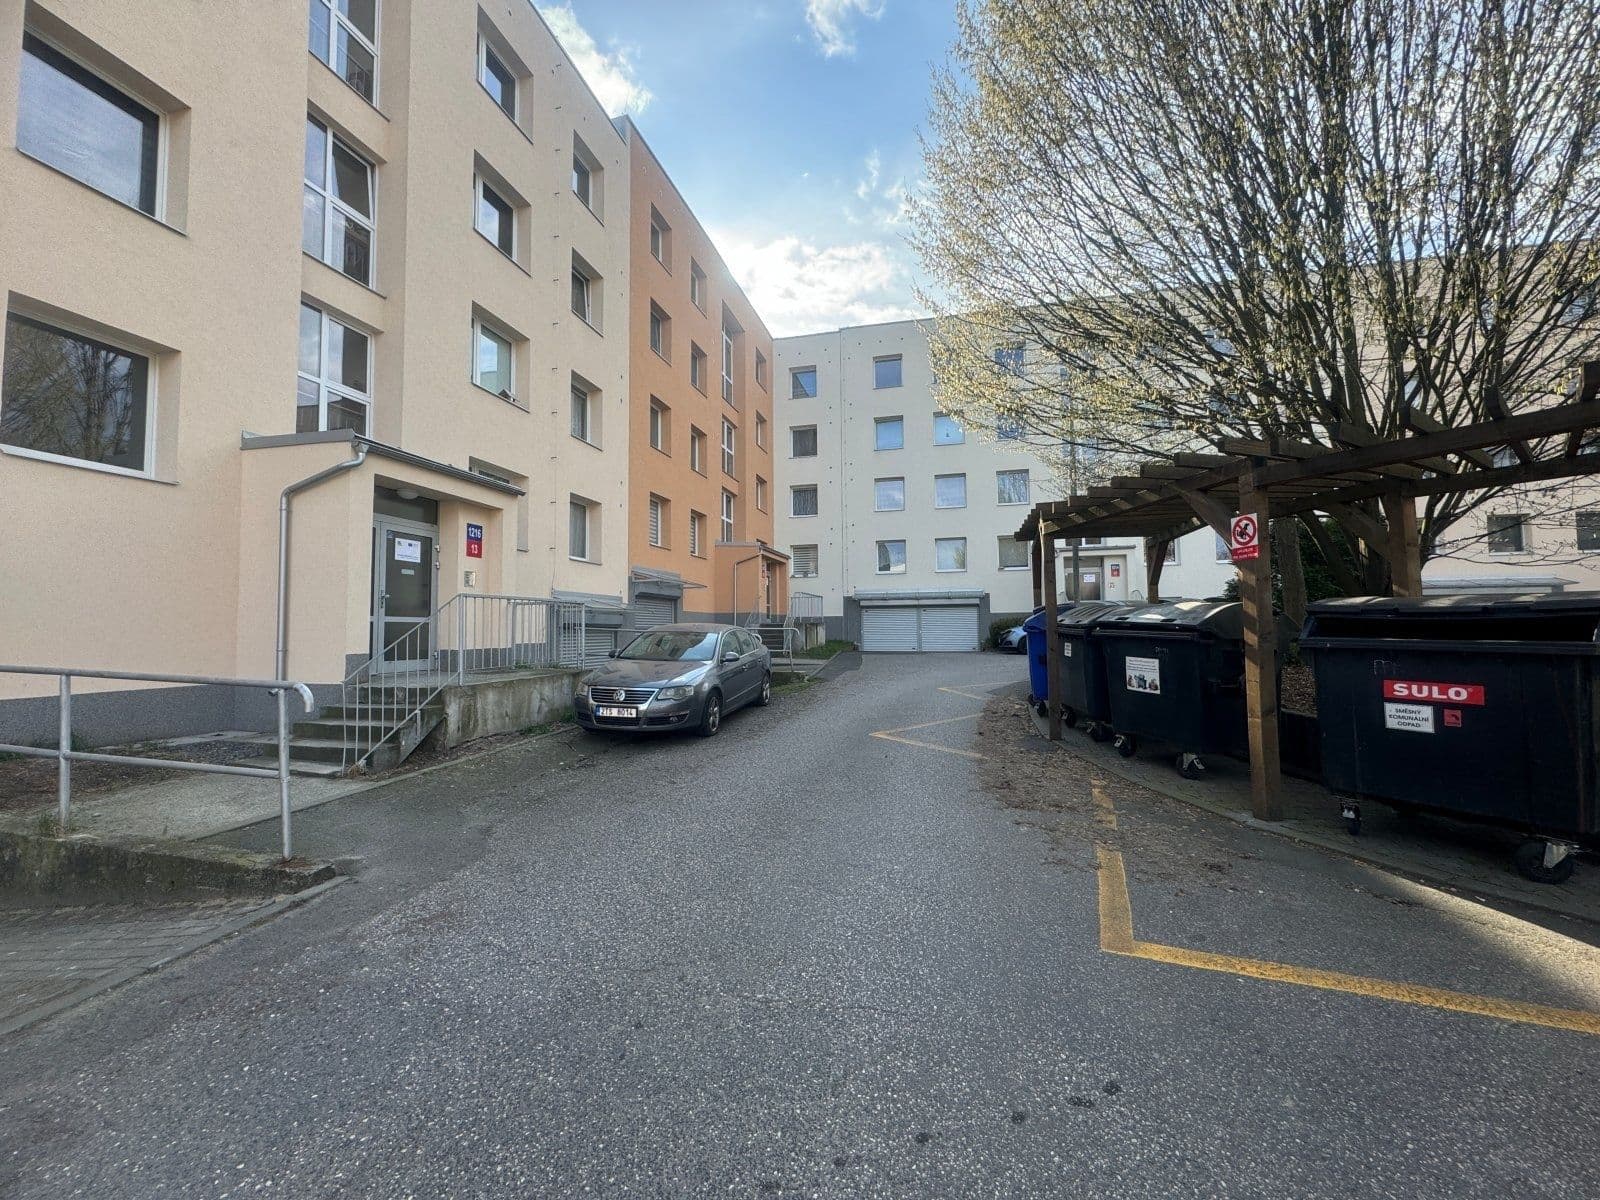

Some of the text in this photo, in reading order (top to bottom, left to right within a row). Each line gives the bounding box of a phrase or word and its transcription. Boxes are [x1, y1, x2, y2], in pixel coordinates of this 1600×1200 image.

[468, 527, 481, 538] 1216
[471, 545, 479, 554] 13
[1393, 683, 1468, 701] SULO
[1388, 714, 1429, 722] KOMUNÁLNÍ
